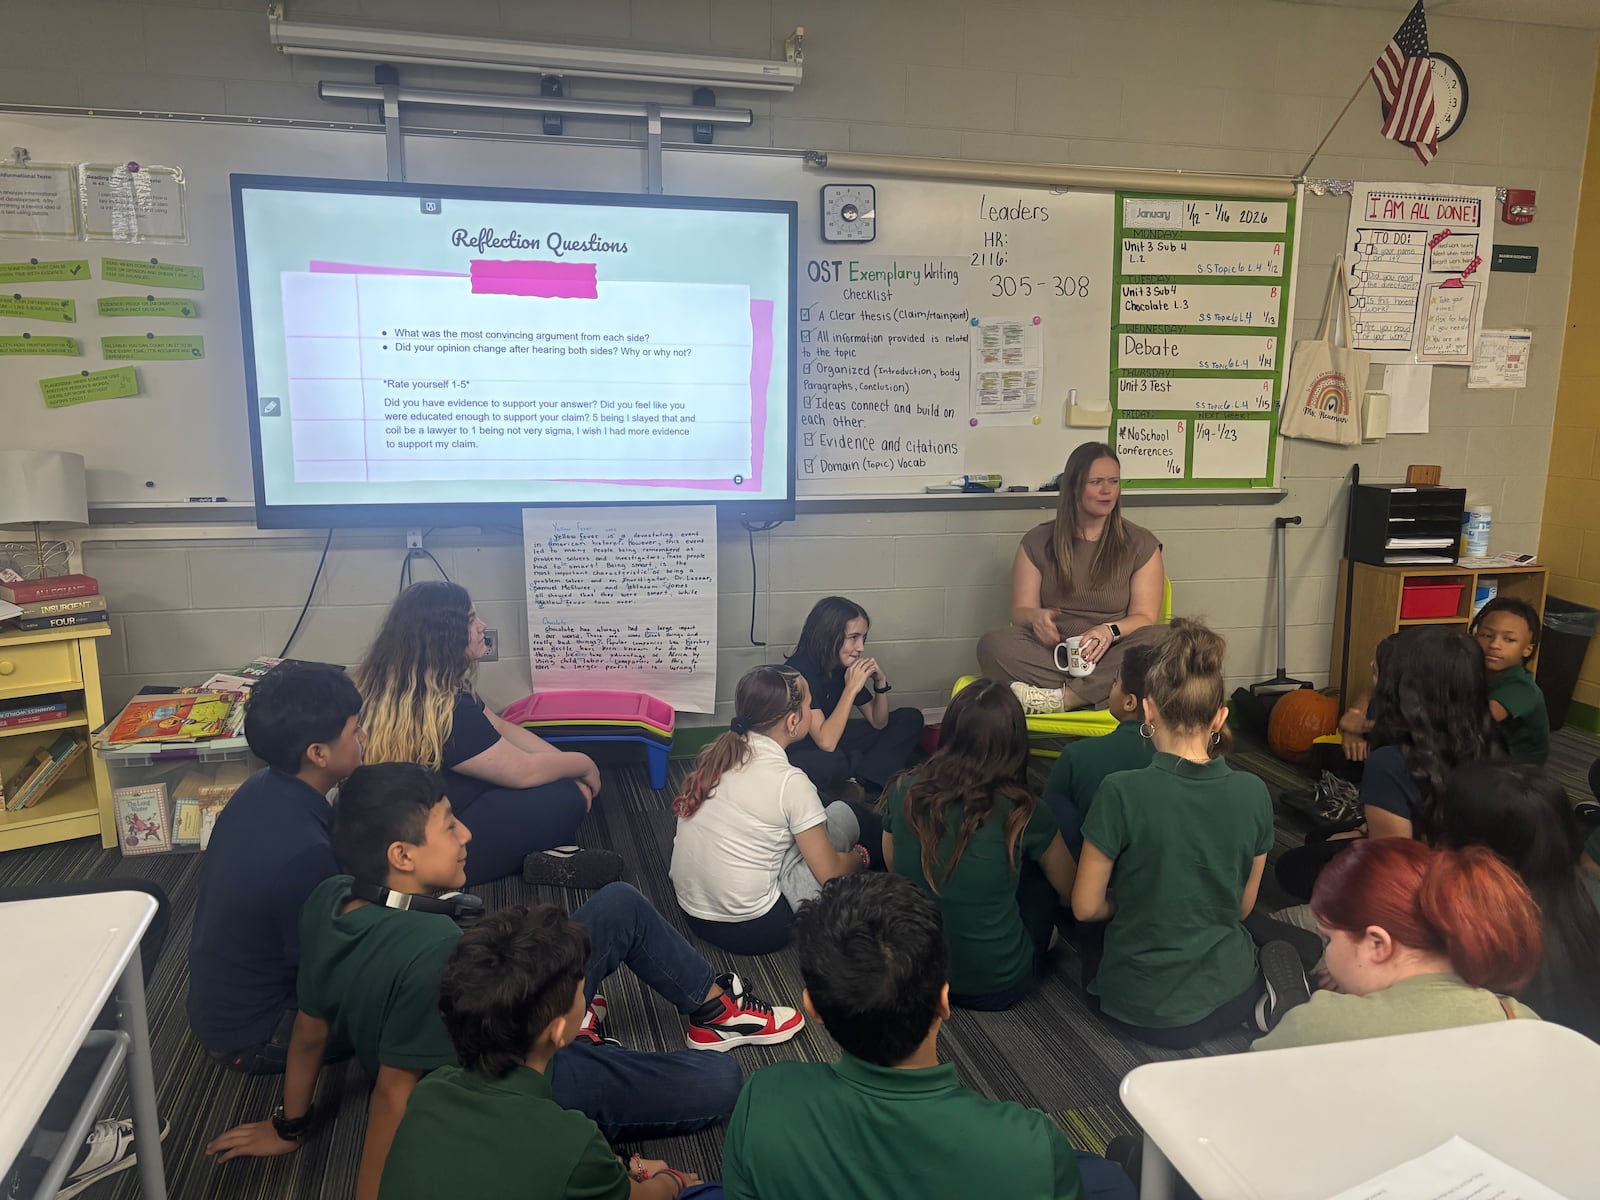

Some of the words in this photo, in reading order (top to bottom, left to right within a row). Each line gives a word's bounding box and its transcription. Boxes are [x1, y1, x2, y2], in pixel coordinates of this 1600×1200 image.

[979, 194, 1049, 222] Leaders
[1137, 208, 1171, 220] January
[1187, 203, 1200, 226] 1/12
[1215, 203, 1230, 223] 1/16
[1239, 210, 1268, 223] 2026
[1369, 198, 1380, 218] I
[1384, 200, 1404, 219] AM
[1411, 202, 1429, 221] ALL
[1437, 205, 1477, 223] DONE!
[452, 228, 540, 252] Reflection
[547, 232, 628, 256] Questions
[984, 232, 1009, 247] HR:
[1374, 232, 1388, 243] TO
[1394, 233, 1410, 244] DO:
[1124, 241, 1144, 251] Unit
[1148, 242, 1153, 251] 3
[1158, 242, 1176, 251] Sub
[1181, 243, 1187, 251] 4
[1273, 244, 1280, 255] A
[970, 252, 1008, 267] 2116:
[1130, 255, 1145, 263] L.2
[808, 260, 842, 282] OST
[849, 261, 920, 287] Exemplary
[924, 261, 959, 285] Writing
[844, 288, 893, 301] Checklist
[1125, 301, 1169, 311] Chocolate
[1174, 300, 1189, 310] L.3
[819, 310, 824, 321] A
[829, 310, 856, 320] Clear
[860, 310, 891, 320] thesis
[395, 328, 419, 337] What
[422, 330, 440, 338] was
[444, 329, 457, 338] the
[460, 330, 483, 338] most
[486, 330, 533, 341] convincing
[536, 333, 578, 341] argument
[581, 333, 600, 341] from
[603, 333, 624, 341] each
[627, 334, 650, 342] side?
[817, 330, 828, 342] All
[833, 330, 883, 343] information
[889, 332, 925, 345] provided
[395, 343, 411, 351] Did
[414, 344, 434, 353] your
[437, 344, 470, 353] opinion
[473, 345, 506, 354] change
[509, 345, 529, 353] after
[532, 346, 565, 355] hearing
[568, 346, 587, 354] both
[590, 347, 618, 355] sides?
[621, 347, 640, 357] Why
[654, 350, 671, 358] why
[802, 348, 811, 357] to
[817, 347, 831, 357] the
[835, 347, 856, 359] topic
[1125, 336, 1179, 356] Debate
[817, 363, 870, 377] Organized
[874, 365, 936, 379] (Introduction,
[940, 368, 960, 381] body
[412, 380, 448, 390] yourself
[804, 380, 857, 393] Paragraphs,
[860, 382, 909, 394] Conclusion)
[1120, 380, 1138, 392] Unit
[1140, 381, 1147, 391] 3
[1150, 380, 1172, 392] Test
[384, 398, 400, 406] Did
[403, 400, 419, 408] you
[423, 399, 445, 407] have
[448, 399, 488, 407] evidence
[503, 400, 536, 409] support
[539, 401, 558, 409] your
[618, 402, 633, 410] you
[635, 401, 650, 409] feel
[653, 401, 667, 409] like
[670, 403, 685, 411] you
[815, 397, 846, 410] Ideas
[852, 400, 889, 412] connect
[894, 404, 910, 414] and
[917, 404, 939, 417] build
[944, 408, 954, 419] on
[411, 412, 452, 420] educated
[456, 413, 489, 423] enough
[493, 413, 501, 421] to
[504, 414, 537, 423] support
[540, 414, 559, 423] your
[562, 414, 589, 422] claim?
[601, 414, 624, 423] being
[632, 414, 659, 424] slayed
[801, 414, 825, 426] each
[833, 415, 867, 428] other.
[1128, 427, 1140, 441] No
[1140, 426, 1169, 441] School
[387, 440, 395, 448] to
[398, 441, 432, 450] support
[436, 442, 449, 450] my
[452, 440, 478, 448] claim.
[820, 434, 875, 451] Evidence
[881, 437, 900, 451] and
[906, 440, 958, 454] citations
[1118, 445, 1174, 456] Conferences
[821, 459, 859, 473] Domain
[863, 457, 894, 471] (Topic)
[898, 458, 926, 468] Vocab
[41, 601, 92, 614] INSURGENT
[50, 617, 75, 627] FOUR
